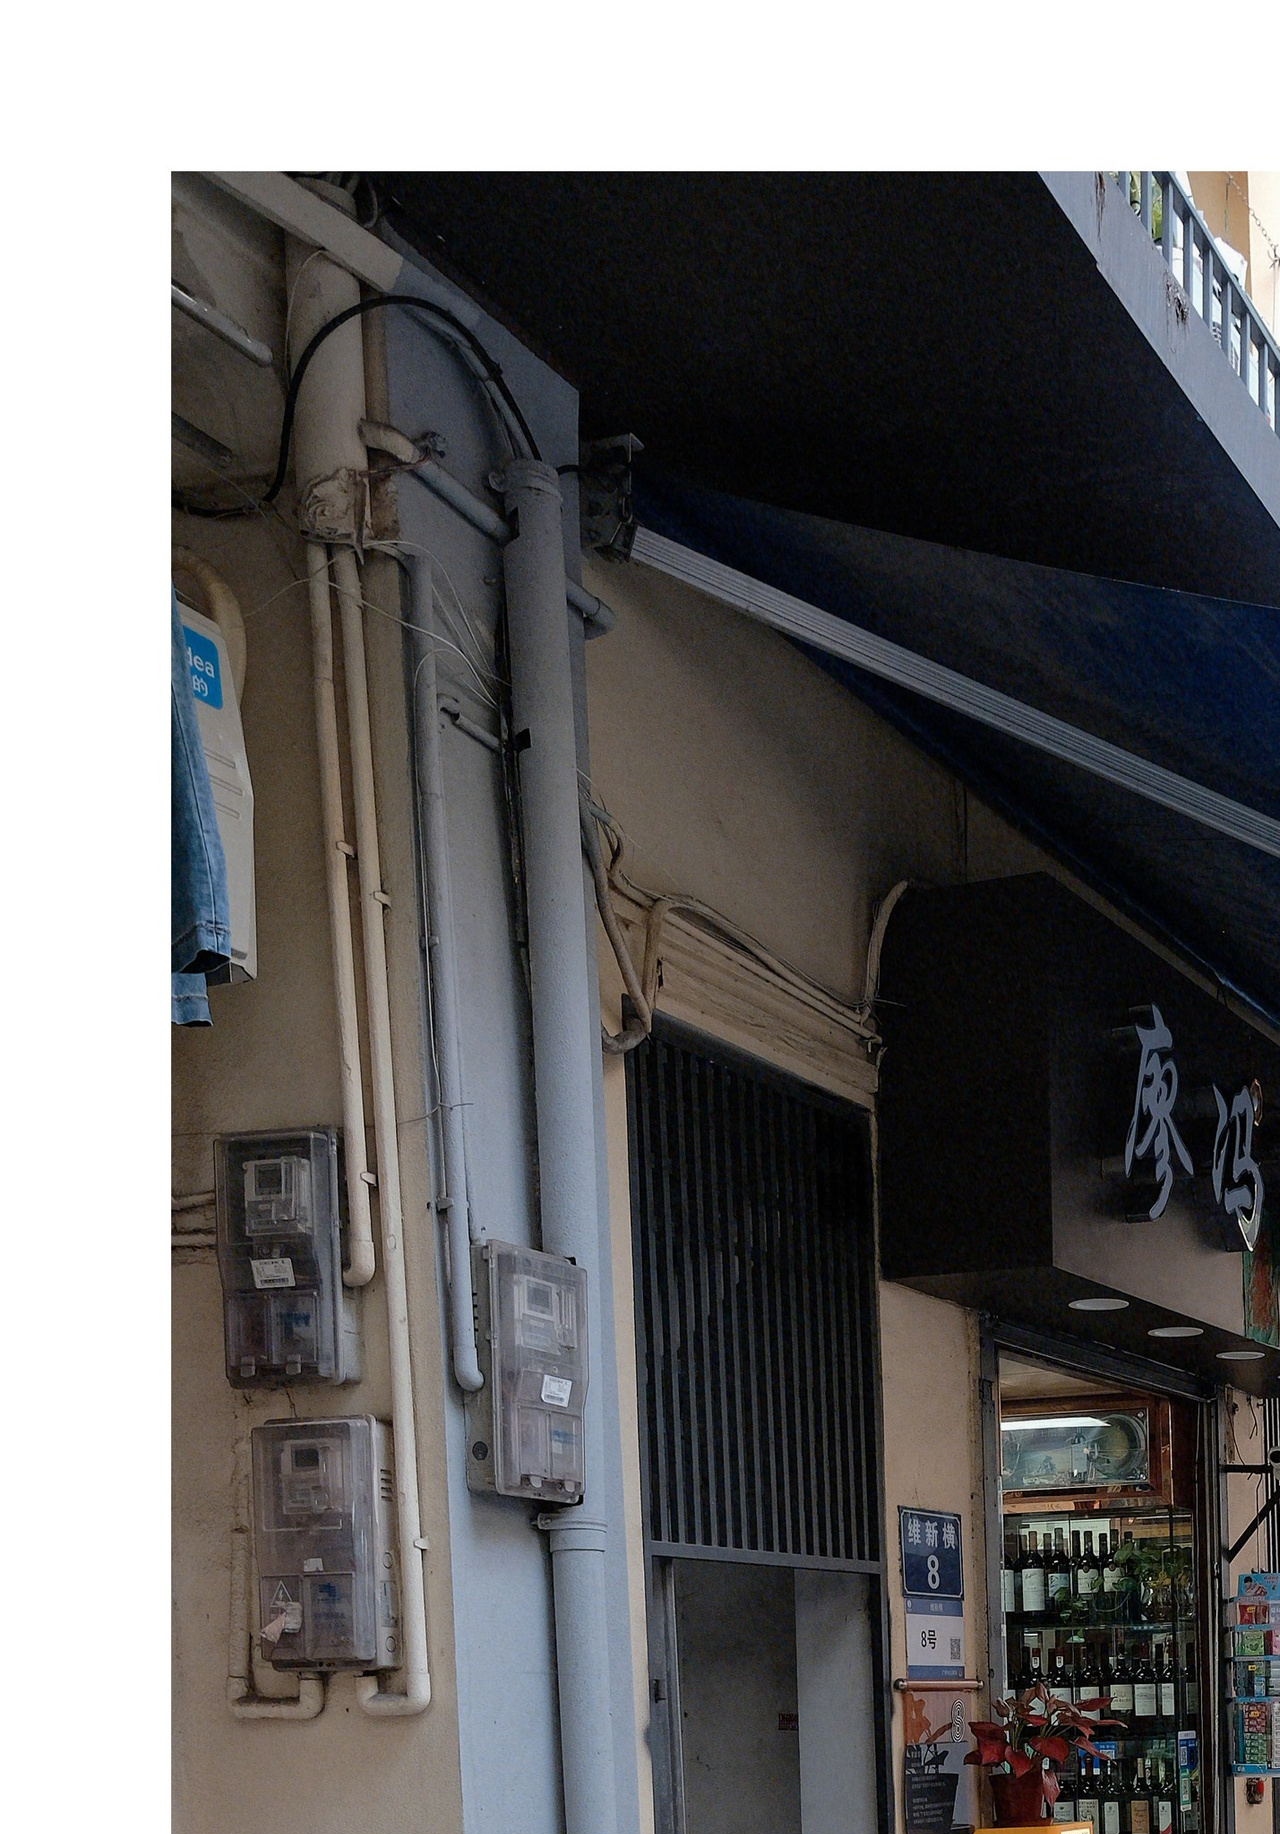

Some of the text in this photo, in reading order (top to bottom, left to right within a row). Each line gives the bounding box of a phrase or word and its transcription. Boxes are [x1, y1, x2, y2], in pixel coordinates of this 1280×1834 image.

[907, 1518, 956, 1550] 维新横
[926, 1554, 940, 1590] 8
[920, 1629, 938, 1650] 8号
